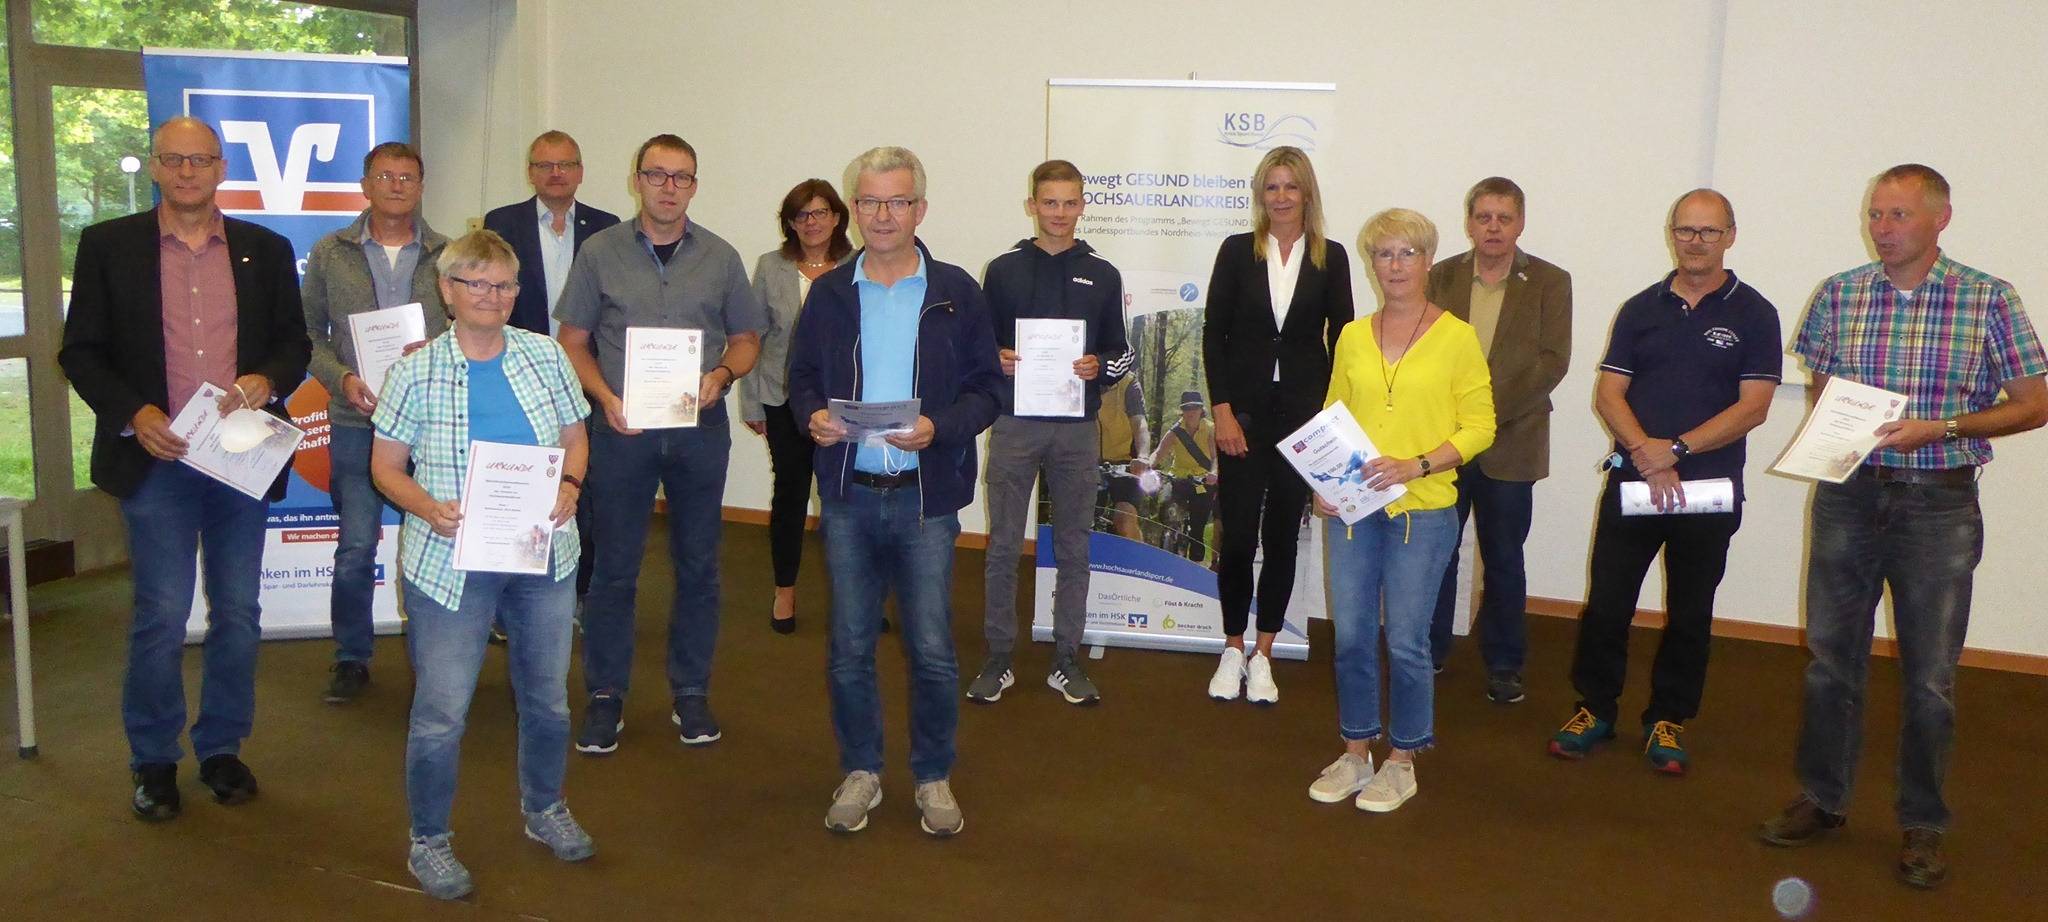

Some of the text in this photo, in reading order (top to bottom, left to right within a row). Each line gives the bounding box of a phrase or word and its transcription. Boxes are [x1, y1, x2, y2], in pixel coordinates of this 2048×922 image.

[1224, 112, 1266, 131] KSB
[1126, 172, 1189, 187] GESUND
[1192, 175, 1246, 189] bleiben
[1083, 192, 1249, 209] OCHSAUERLANDKREIS!
[1116, 216, 1129, 224] des
[1072, 276, 1093, 286] adidas
[306, 424, 331, 436] sere
[283, 514, 299, 522] das
[299, 513, 314, 522] ihn
[301, 532, 330, 540] machen
[294, 566, 311, 578] im
